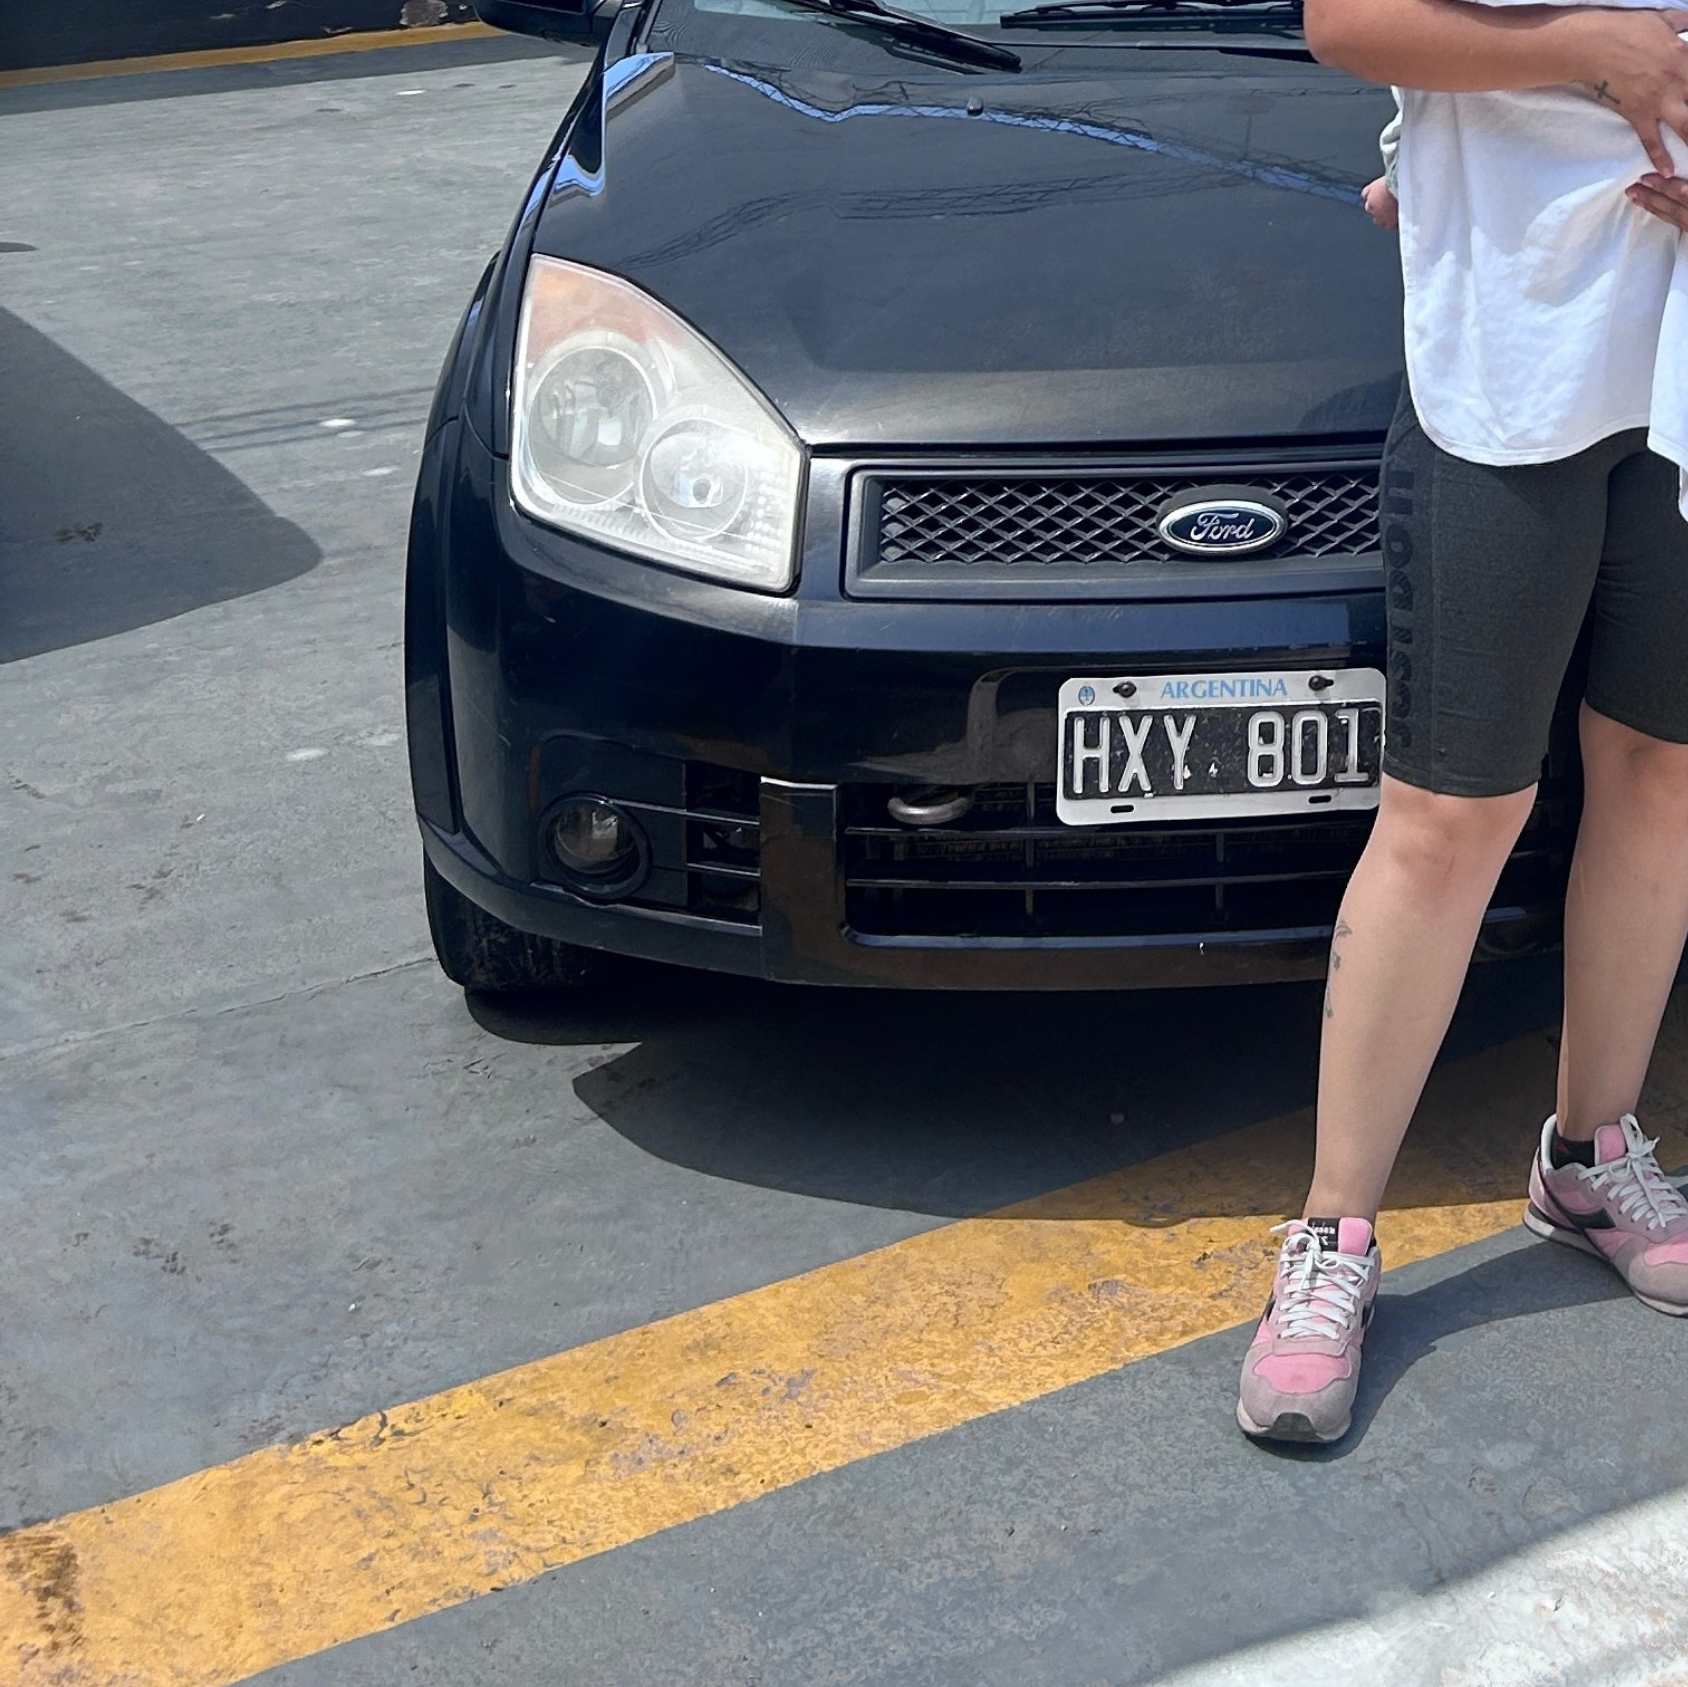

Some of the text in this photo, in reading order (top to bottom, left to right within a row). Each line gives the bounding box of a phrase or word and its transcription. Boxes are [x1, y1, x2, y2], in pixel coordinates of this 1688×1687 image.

[1191, 512, 1255, 541] Ford
[1160, 678, 1288, 700] ARGENTINA
[1072, 708, 1369, 795] HXY 801
